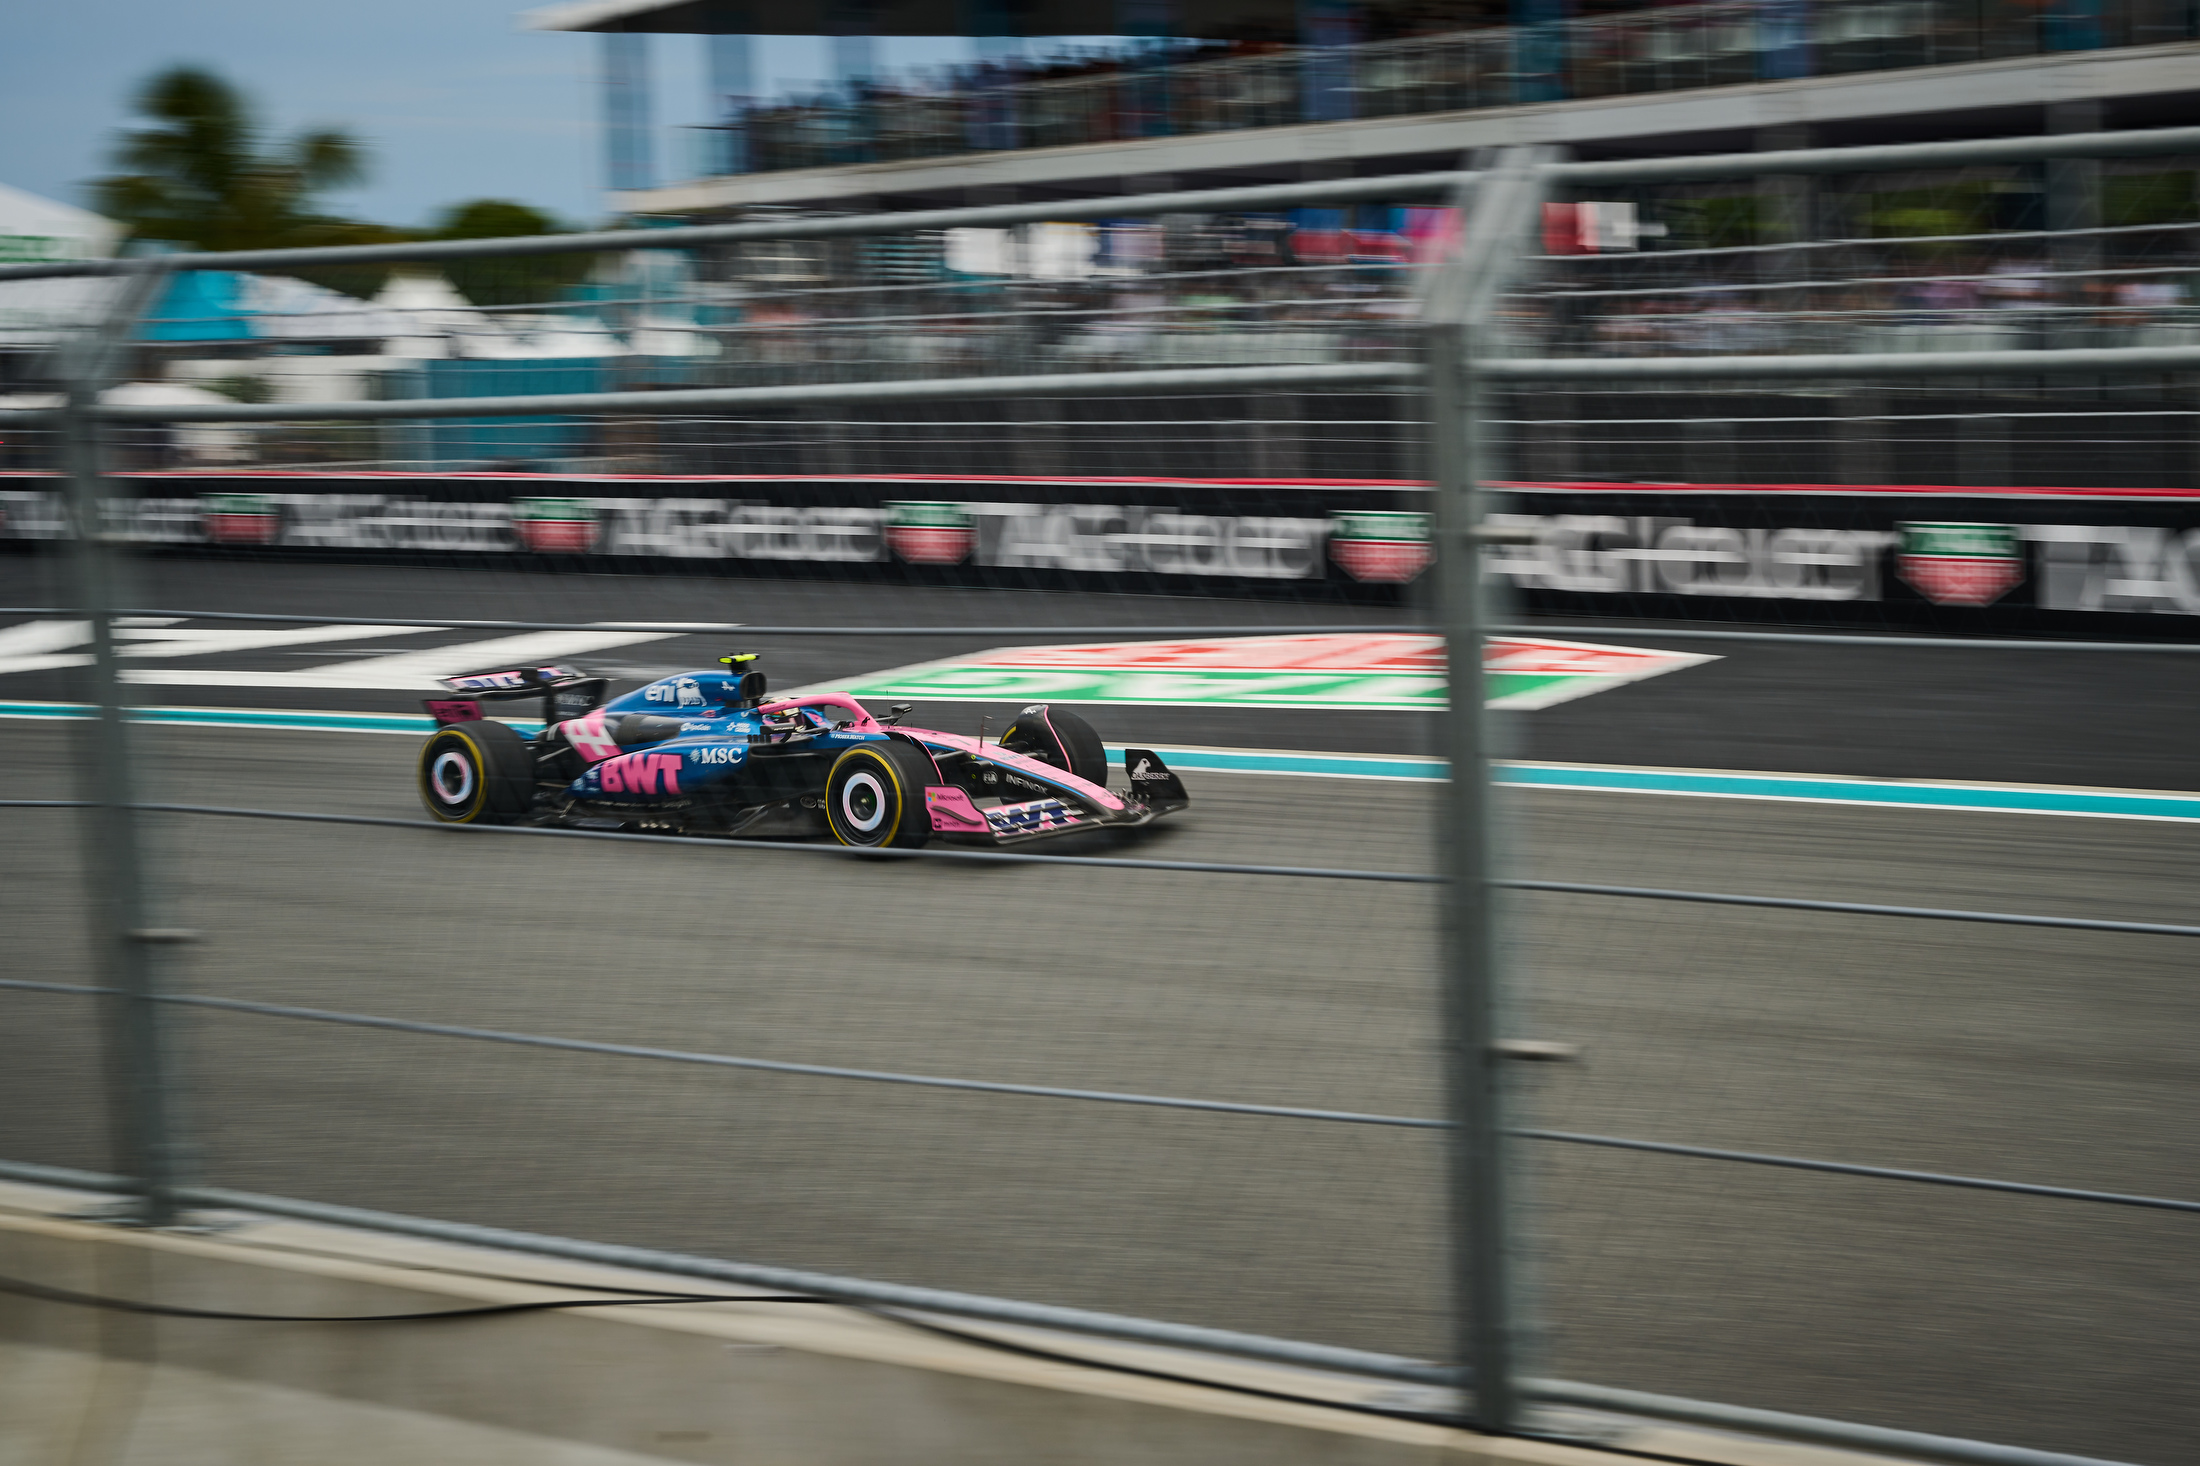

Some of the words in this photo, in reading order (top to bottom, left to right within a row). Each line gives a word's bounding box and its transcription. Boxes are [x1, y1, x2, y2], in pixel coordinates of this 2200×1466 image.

[644, 685, 675, 702] eni
[701, 747, 742, 764] MSC
[600, 753, 683, 795] BWT
[1005, 773, 1048, 796] INFINOX
